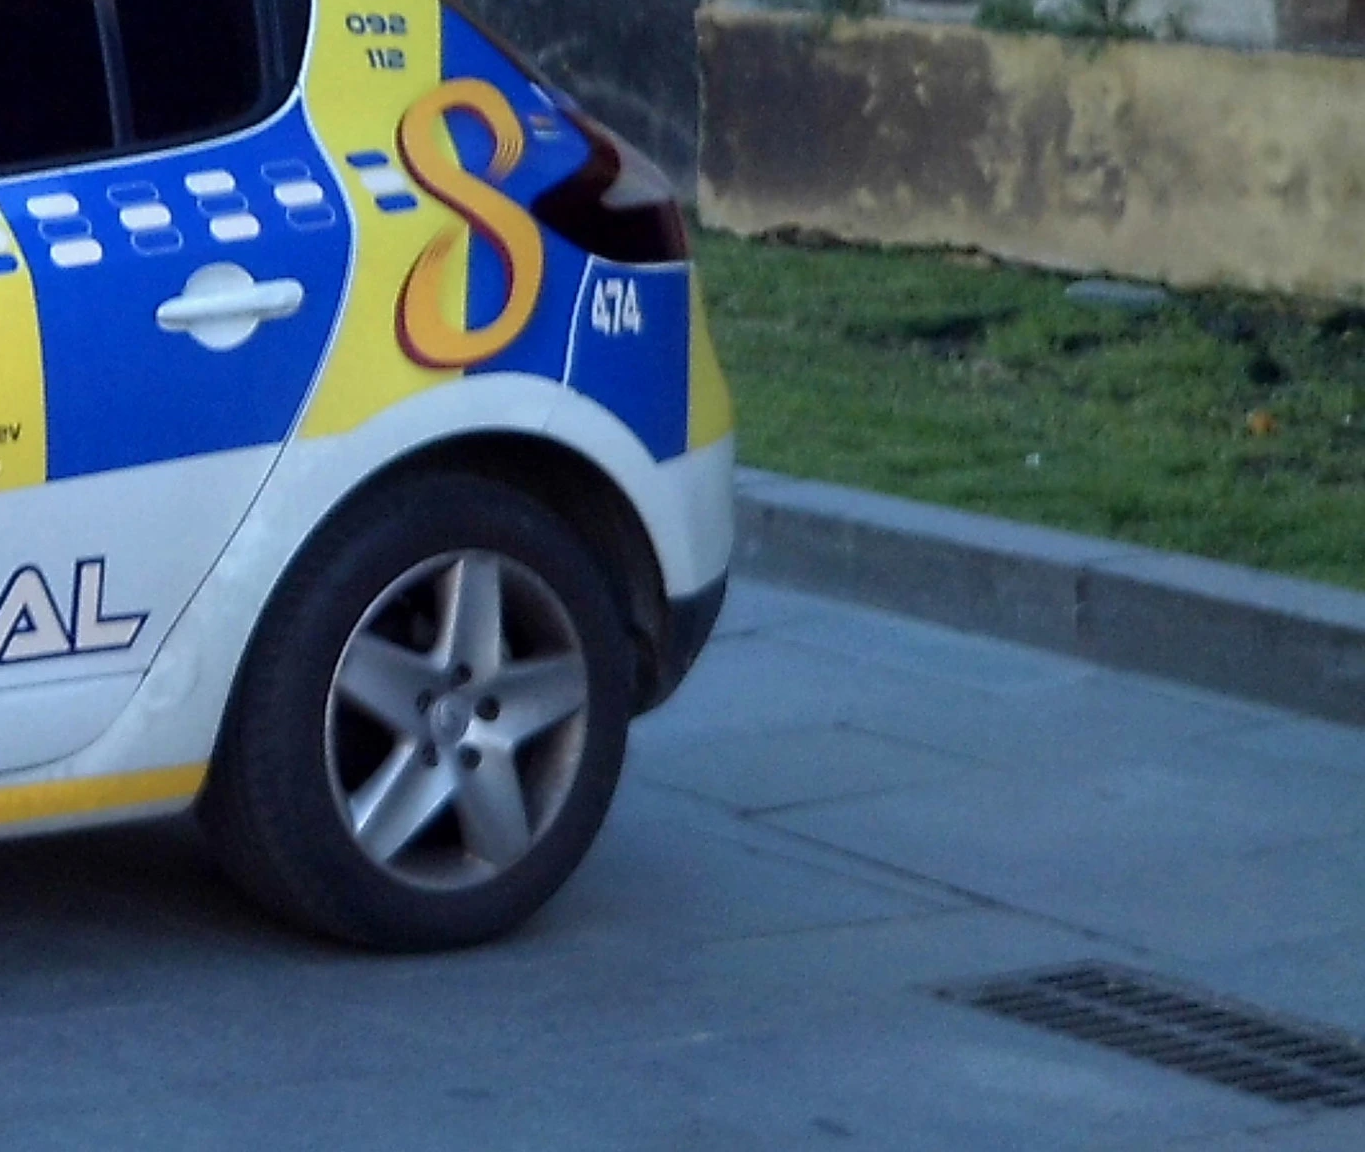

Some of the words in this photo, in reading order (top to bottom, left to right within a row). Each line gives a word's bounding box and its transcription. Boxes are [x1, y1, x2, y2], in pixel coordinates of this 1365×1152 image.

[345, 12, 407, 36] 092
[365, 47, 406, 70] 112
[590, 277, 642, 336] 474
